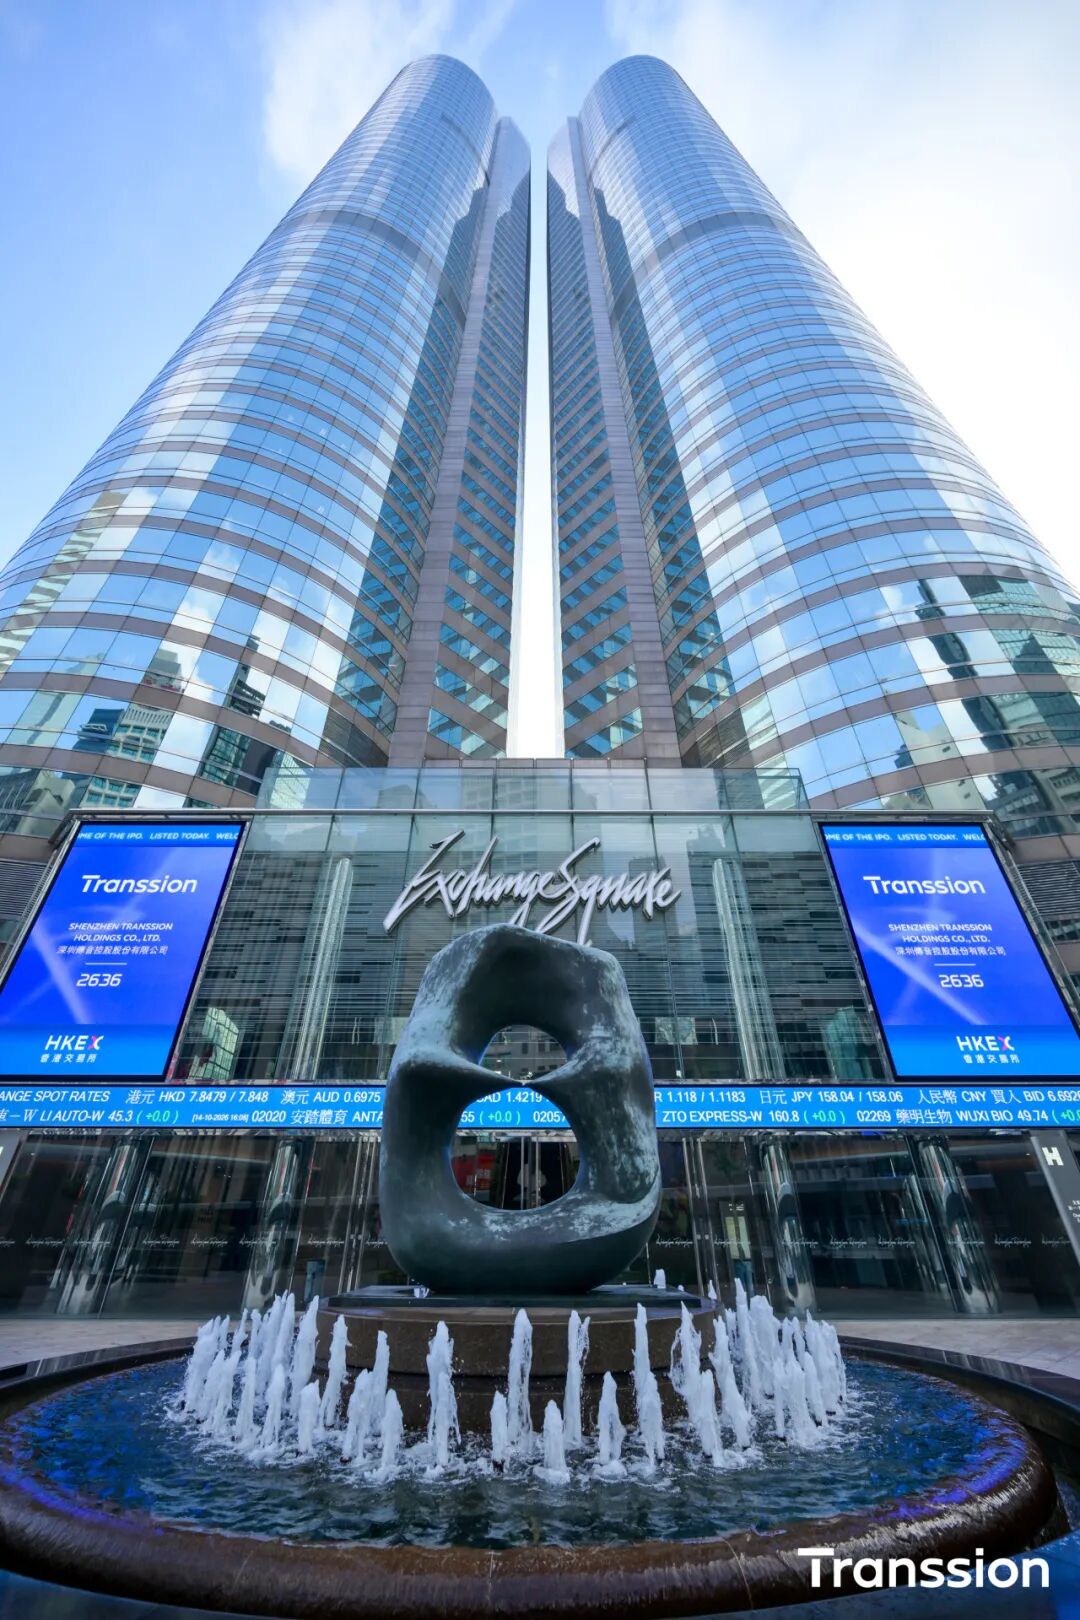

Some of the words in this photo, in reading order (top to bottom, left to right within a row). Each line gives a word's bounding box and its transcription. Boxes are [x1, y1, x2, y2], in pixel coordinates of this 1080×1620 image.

[94, 832, 106, 841] OF
[109, 832, 125, 841] THE
[149, 832, 179, 841] LISTED
[842, 833, 854, 842] OF
[856, 833, 874, 842] THE
[898, 833, 927, 842] LISTED
[82, 874, 198, 893] Transsion
[863, 875, 986, 894] Transsion
[68, 922, 120, 931] SHENZHEN
[121, 922, 174, 931] TRANSSION
[888, 923, 939, 932] SHENZHEN
[940, 923, 993, 932] TRANSSION
[73, 934, 122, 942] HOLDINGS
[902, 934, 951, 943] HOLDINGS
[76, 973, 123, 987] 2636
[938, 974, 985, 988] 2636
[44, 1035, 105, 1051] HKEX
[956, 1035, 1015, 1051] HKEX
[34, 1090, 69, 1102] SPOT
[70, 1090, 111, 1102] RATES
[125, 1089, 155, 1105] 港元
[159, 1091, 186, 1102] HKD
[190, 1091, 226, 1102] 7.8479
[238, 1091, 269, 1102] 7.848
[280, 1089, 309, 1105] 澳元
[313, 1091, 340, 1102] AUD
[343, 1091, 381, 1102] 0.6975
[667, 1091, 697, 1102] 1.118
[708, 1091, 746, 1102] 1.1183
[759, 1090, 788, 1105] 日元
[791, 1091, 813, 1102] JPY
[817, 1091, 855, 1102] 158.04
[866, 1091, 903, 1102] 158.06
[918, 1089, 957, 1104] 人民幣
[961, 1091, 986, 1102] CNY
[1023, 1091, 1045, 1102] BID
[40, 1110, 52, 1122] LI
[53, 1110, 104, 1122] AUTO-W
[108, 1110, 133, 1122] 45.3
[251, 1110, 287, 1122] 02020
[290, 1108, 348, 1125] 安踏體育
[662, 1110, 687, 1122] ZTO
[689, 1110, 762, 1122] EXPRESS-W
[768, 1110, 799, 1122] 160.8
[856, 1110, 891, 1122] 02269
[956, 1110, 990, 1122] WUXI
[991, 1110, 1013, 1122] BIO
[1017, 1110, 1049, 1122] 49.74
[1042, 1147, 1064, 1166] H
